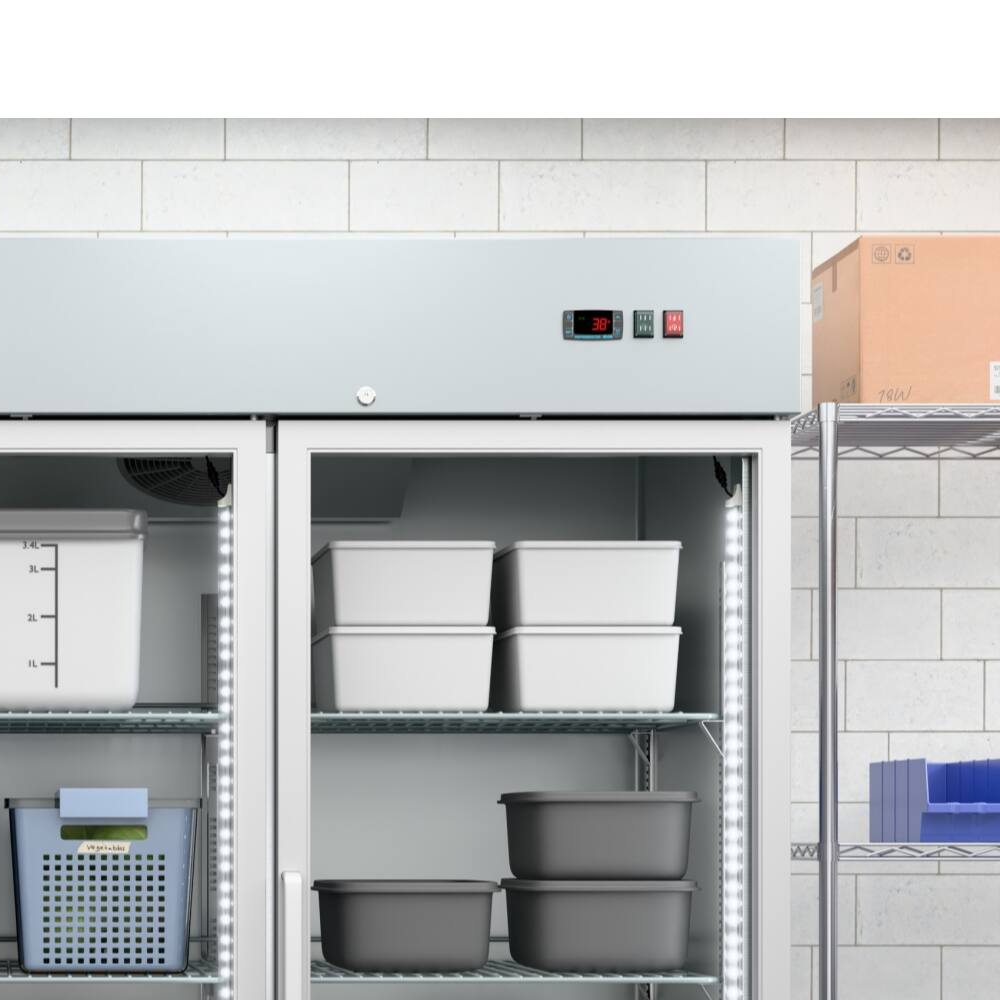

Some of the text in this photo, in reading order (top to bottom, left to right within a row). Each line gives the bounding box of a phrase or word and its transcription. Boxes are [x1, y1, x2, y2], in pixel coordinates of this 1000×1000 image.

[23, 541, 40, 550] 3.4L
[29, 565, 39, 573] 3L
[27, 614, 38, 622] 2L
